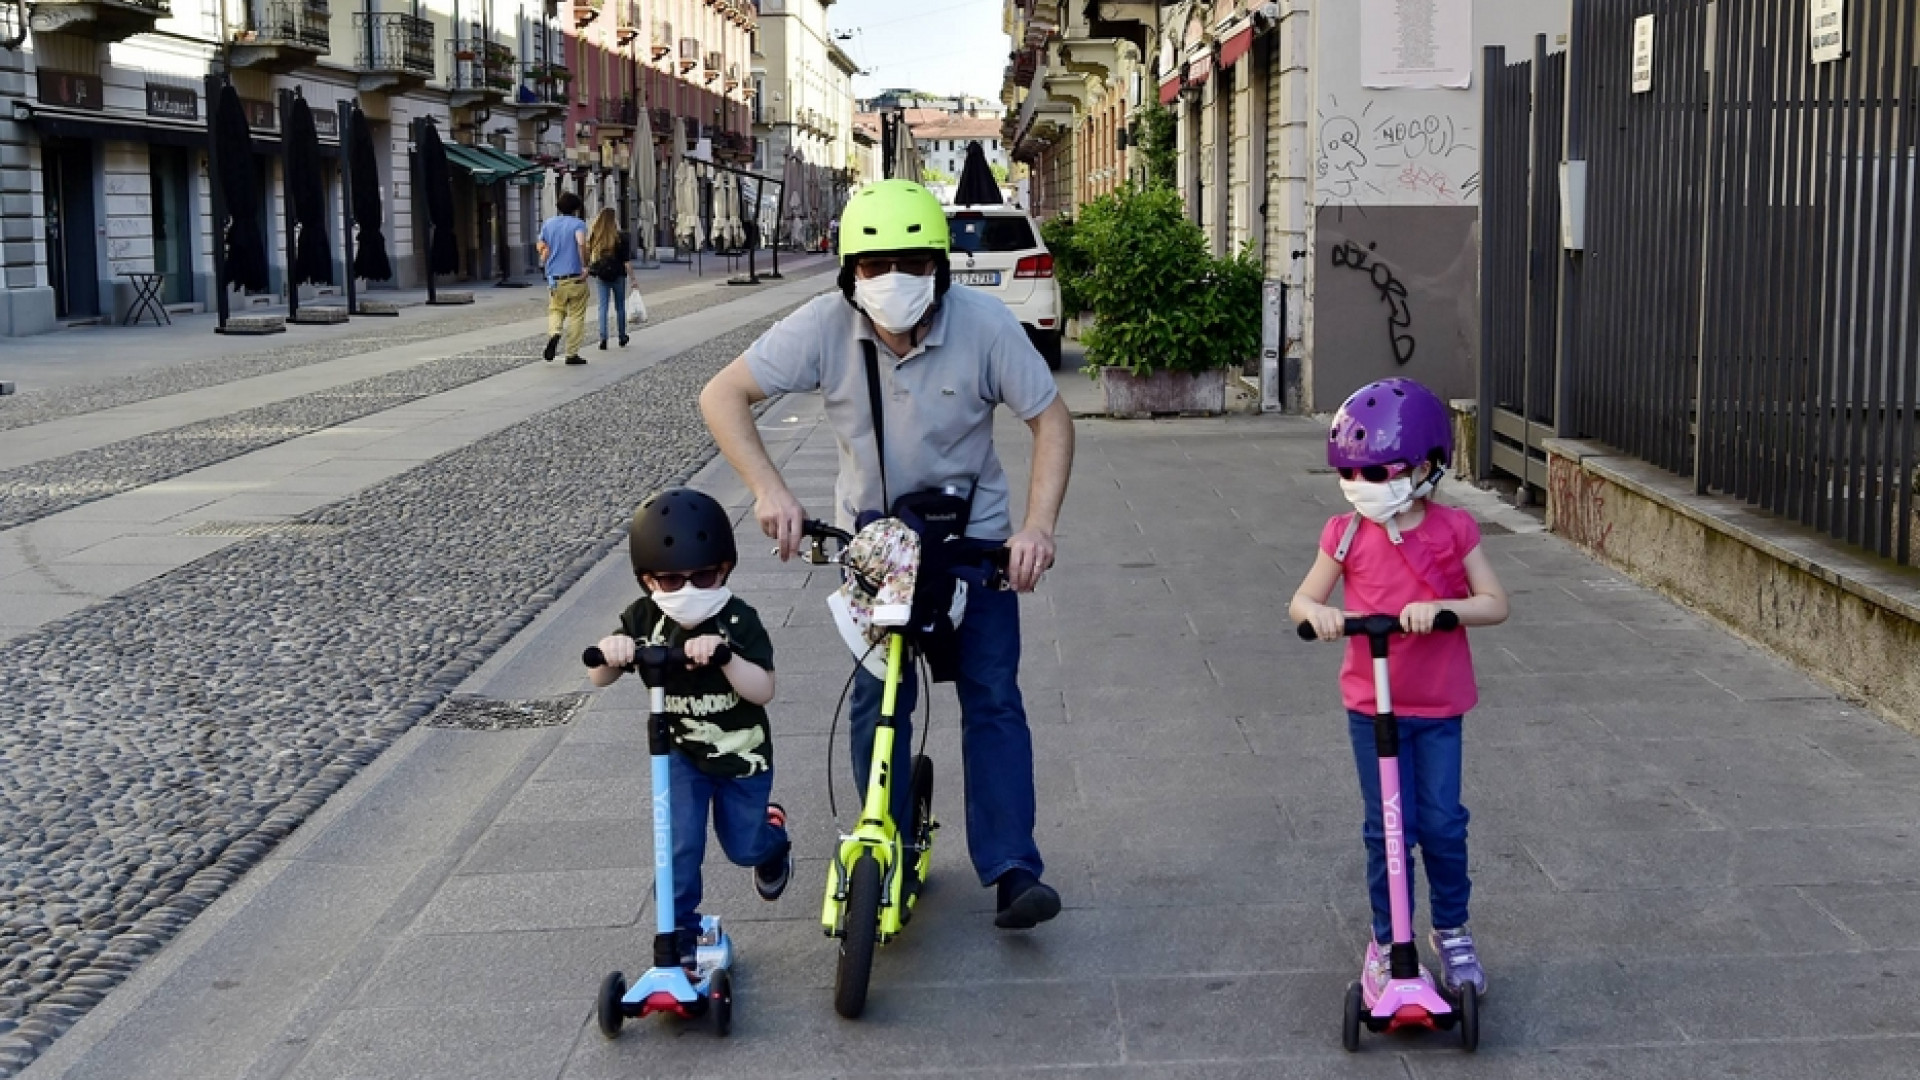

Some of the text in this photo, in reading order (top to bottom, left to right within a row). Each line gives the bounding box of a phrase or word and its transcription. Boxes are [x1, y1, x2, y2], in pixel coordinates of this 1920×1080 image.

[689, 691, 738, 716] WORL
[654, 788, 670, 867] Yoleo
[1384, 791, 1402, 875] Yoleo
